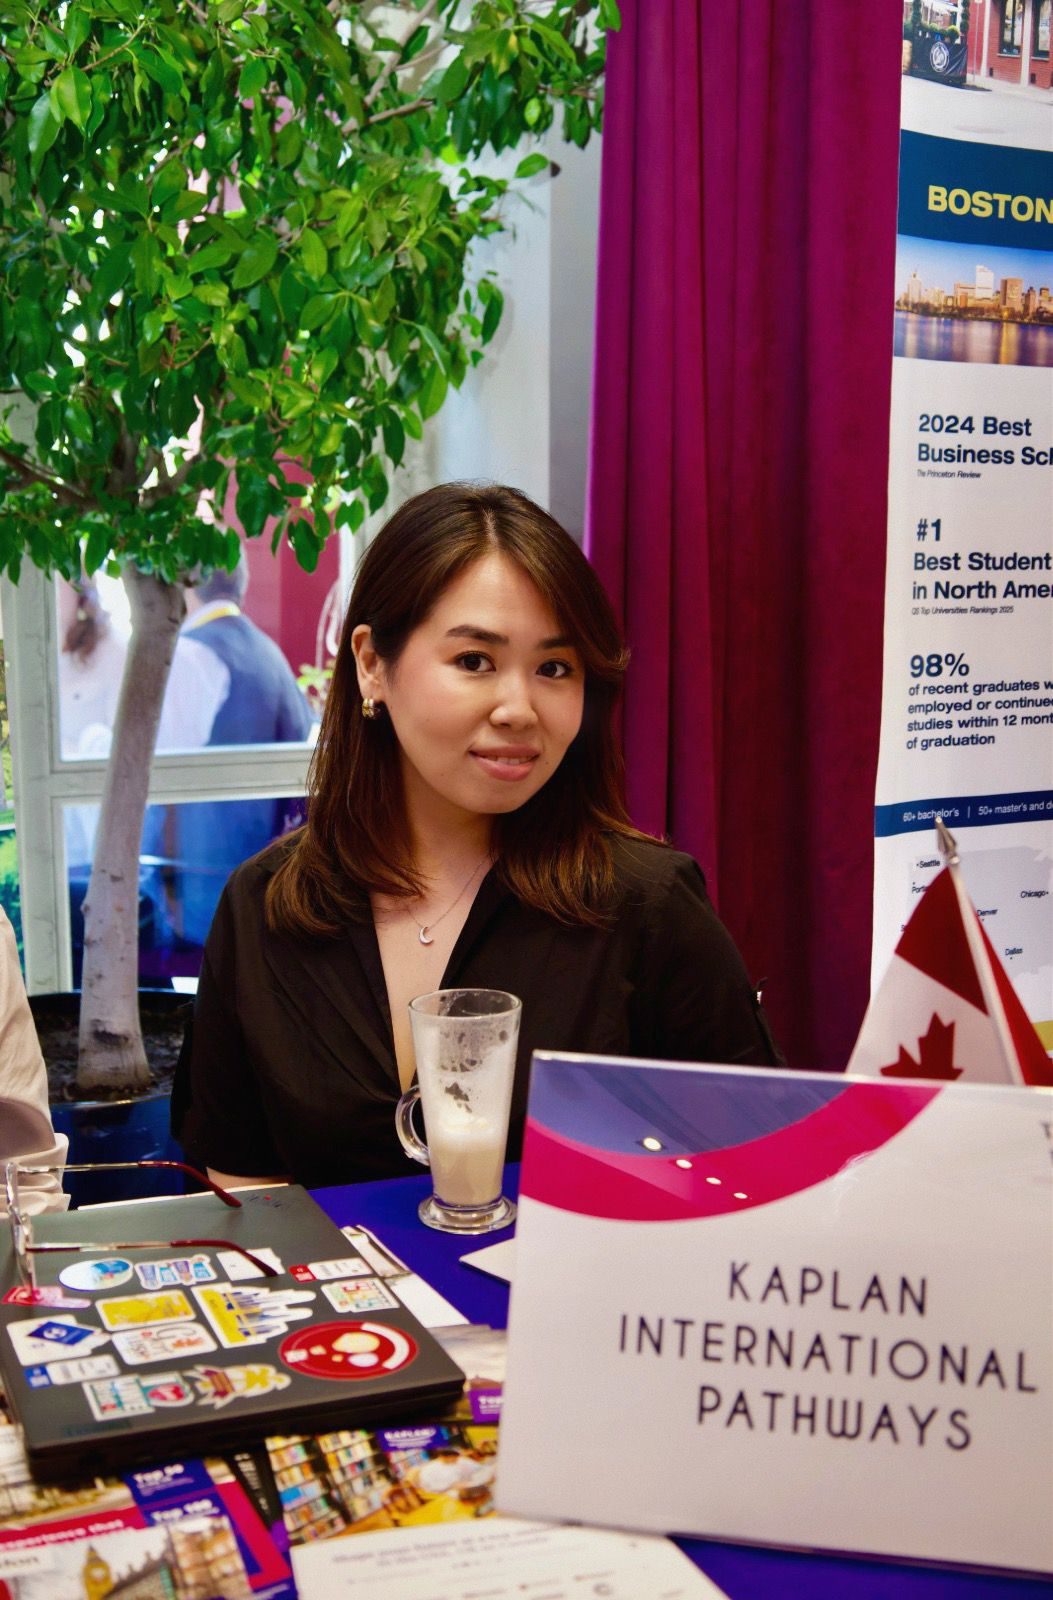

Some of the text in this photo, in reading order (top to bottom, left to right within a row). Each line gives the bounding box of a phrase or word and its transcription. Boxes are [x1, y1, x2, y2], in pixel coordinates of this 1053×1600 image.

[928, 185, 1053, 225] BOSTON
[918, 413, 1033, 437] 2024 Best
[918, 443, 1015, 465] Business
[926, 470, 956, 478] Princeton
[916, 518, 942, 542] #1
[914, 551, 1052, 571] Best Student
[912, 580, 1053, 600] in North Ame
[932, 605, 968, 614] Universities
[970, 605, 998, 615] Rankings
[910, 652, 970, 679] 98%
[908, 683, 920, 697] of
[922, 681, 969, 695] recent
[972, 680, 1041, 696] graduates
[908, 698, 973, 715] employed
[976, 700, 992, 711] or
[907, 718, 954, 732] studies
[957, 715, 999, 729] within
[1002, 714, 1018, 726] 12
[906, 733, 996, 751] of graduation
[917, 808, 959, 820] bachelor's
[978, 805, 993, 815] 50+
[994, 801, 1027, 813] master's
[1029, 800, 1044, 810] and
[920, 860, 940, 868] Seattle
[1020, 890, 1046, 898] Chicago
[1005, 948, 1023, 956] Dallas
[728, 1261, 928, 1317] KAPLAN
[619, 1314, 1038, 1394] INTERNATIONAL
[697, 1385, 973, 1451] PATHWAYS
